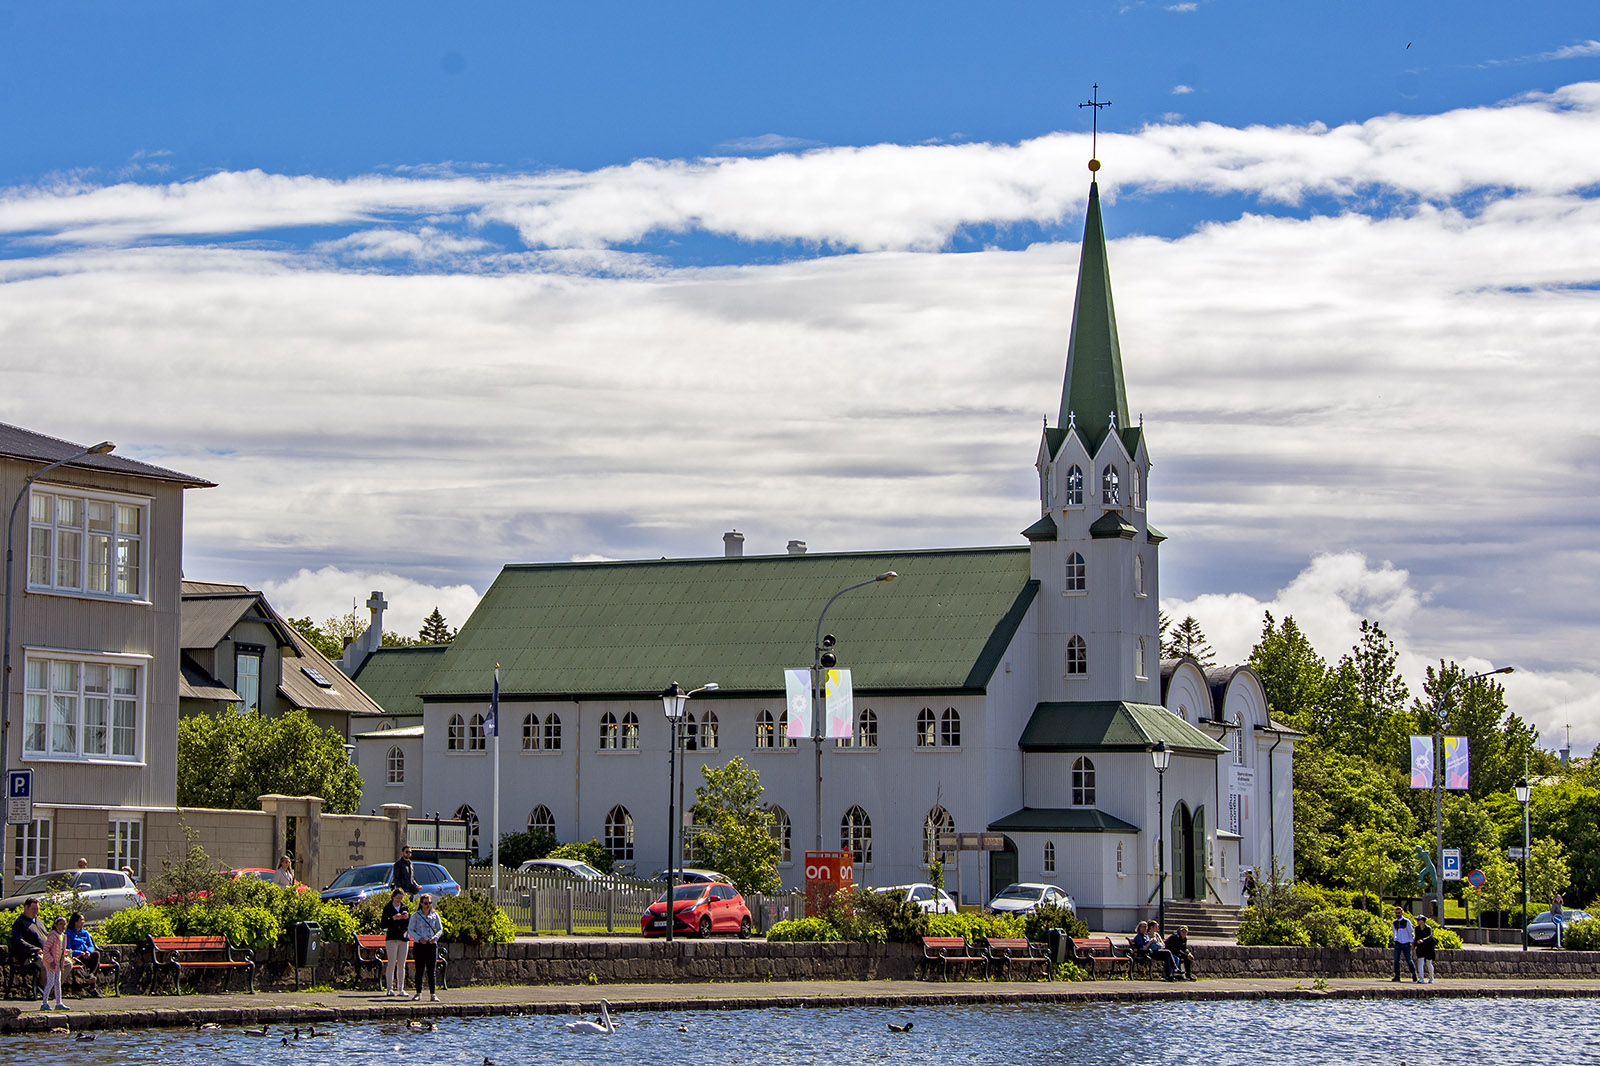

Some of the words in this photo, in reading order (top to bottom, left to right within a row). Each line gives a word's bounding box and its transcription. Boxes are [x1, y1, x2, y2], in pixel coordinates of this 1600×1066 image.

[1448, 858, 1455, 868] P
[806, 865, 830, 879] on
[840, 865, 853, 880] on
